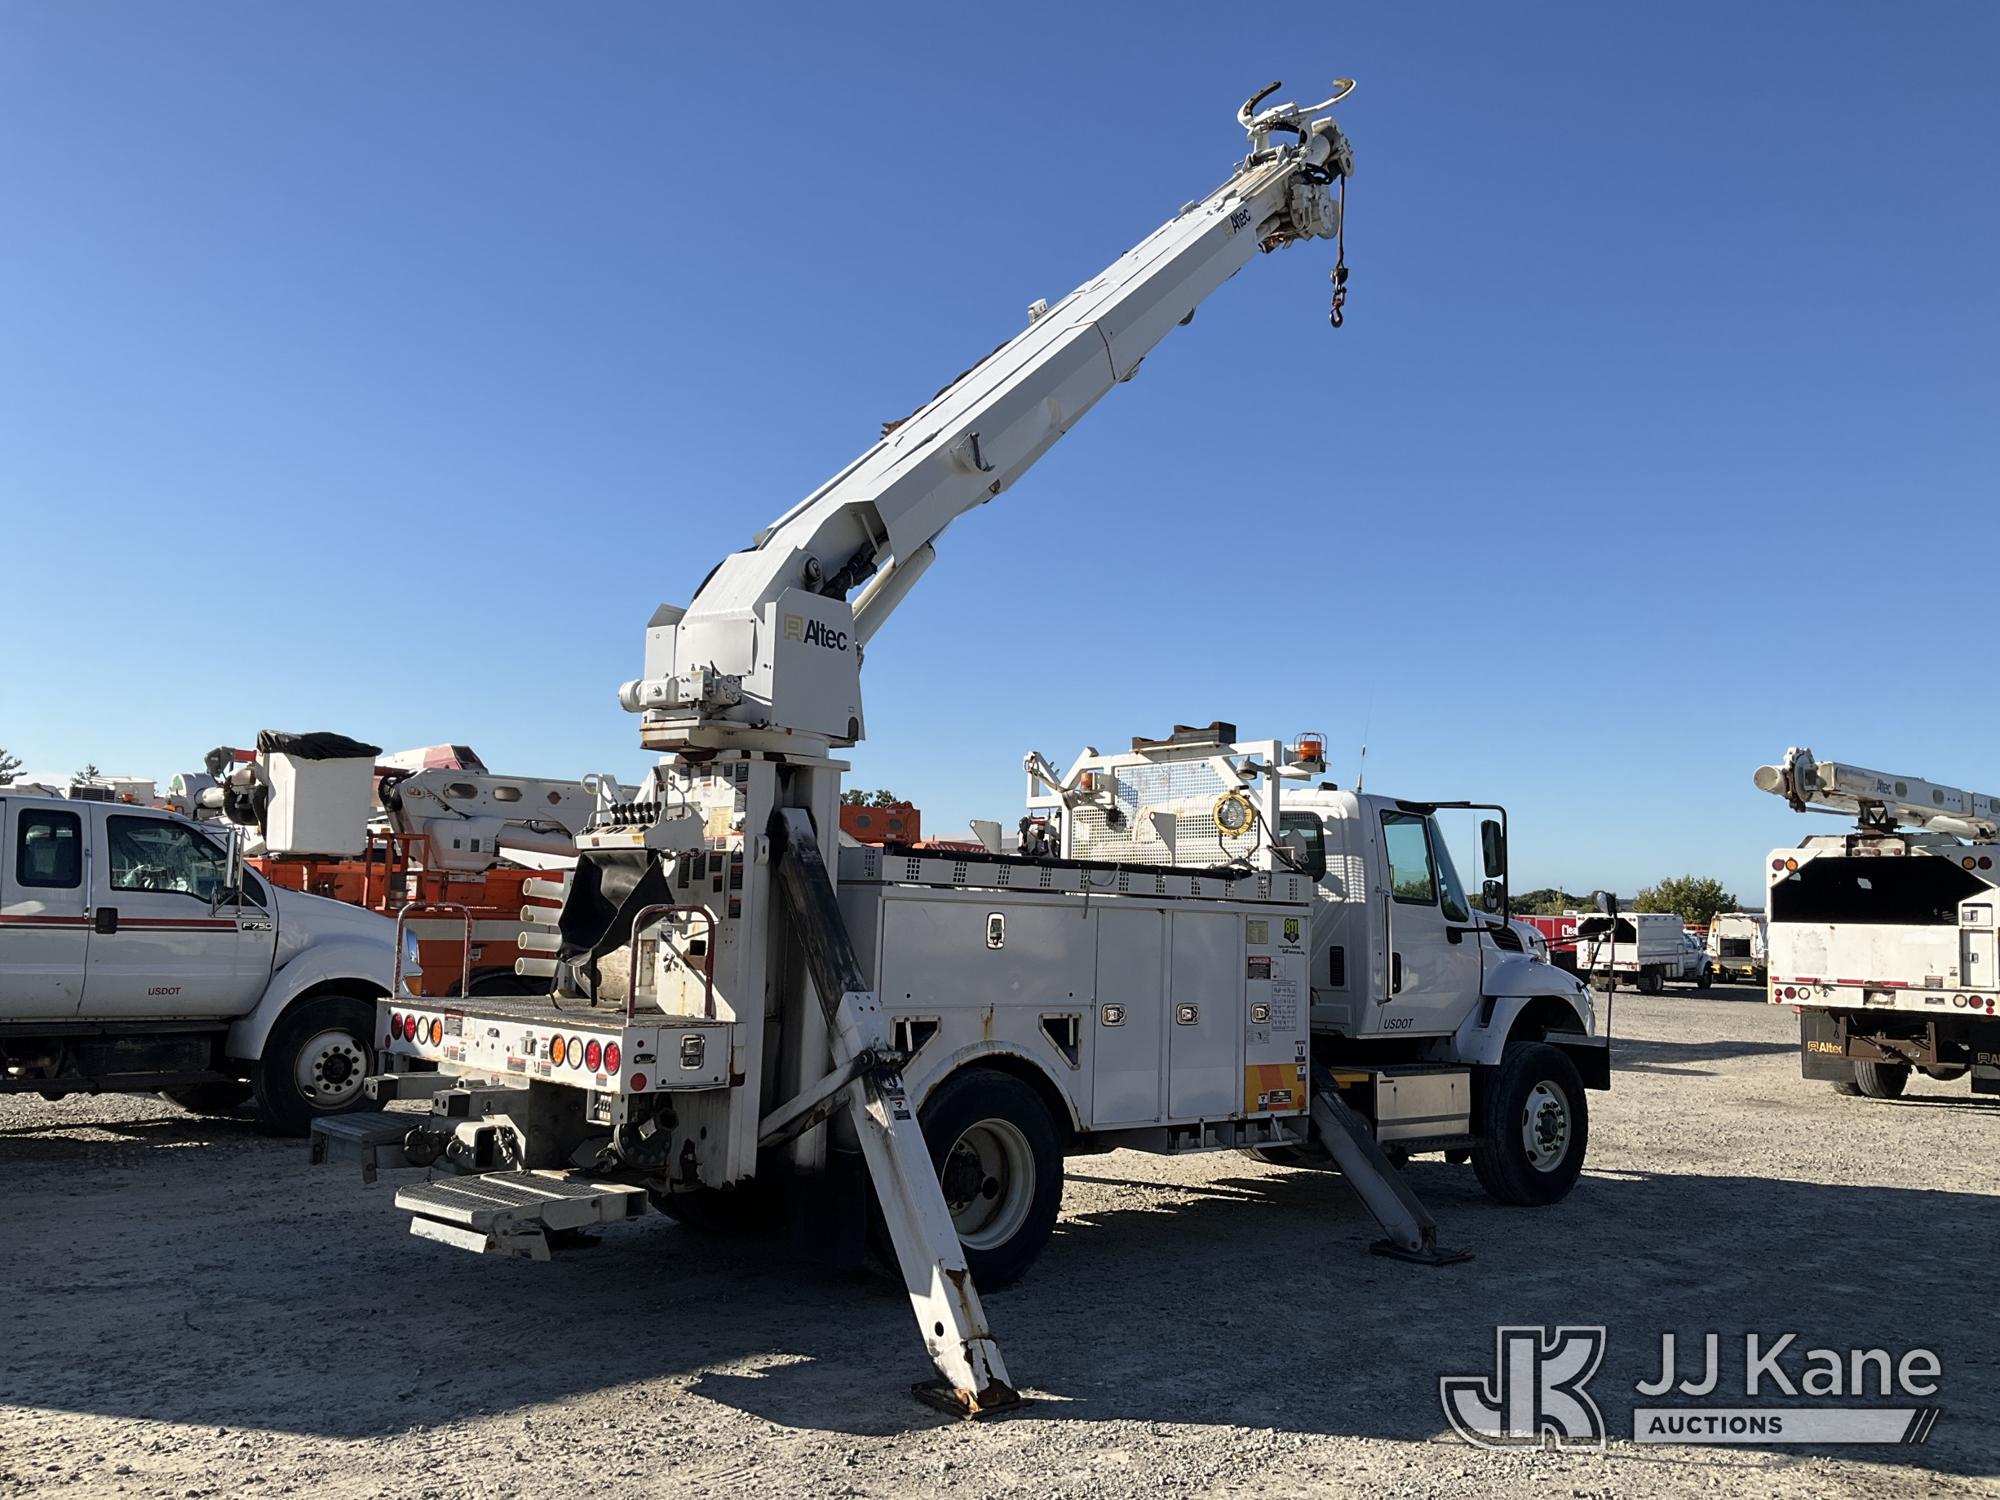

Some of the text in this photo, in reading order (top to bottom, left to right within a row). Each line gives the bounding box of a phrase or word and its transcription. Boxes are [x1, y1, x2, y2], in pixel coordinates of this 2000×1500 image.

[1230, 208, 1251, 234] Altec
[803, 619, 848, 651] Altec
[1284, 918, 1299, 935] 811
[1561, 923, 1578, 938] Clea
[147, 987, 181, 996] USDOT
[1384, 1018, 1414, 1030] USDOT
